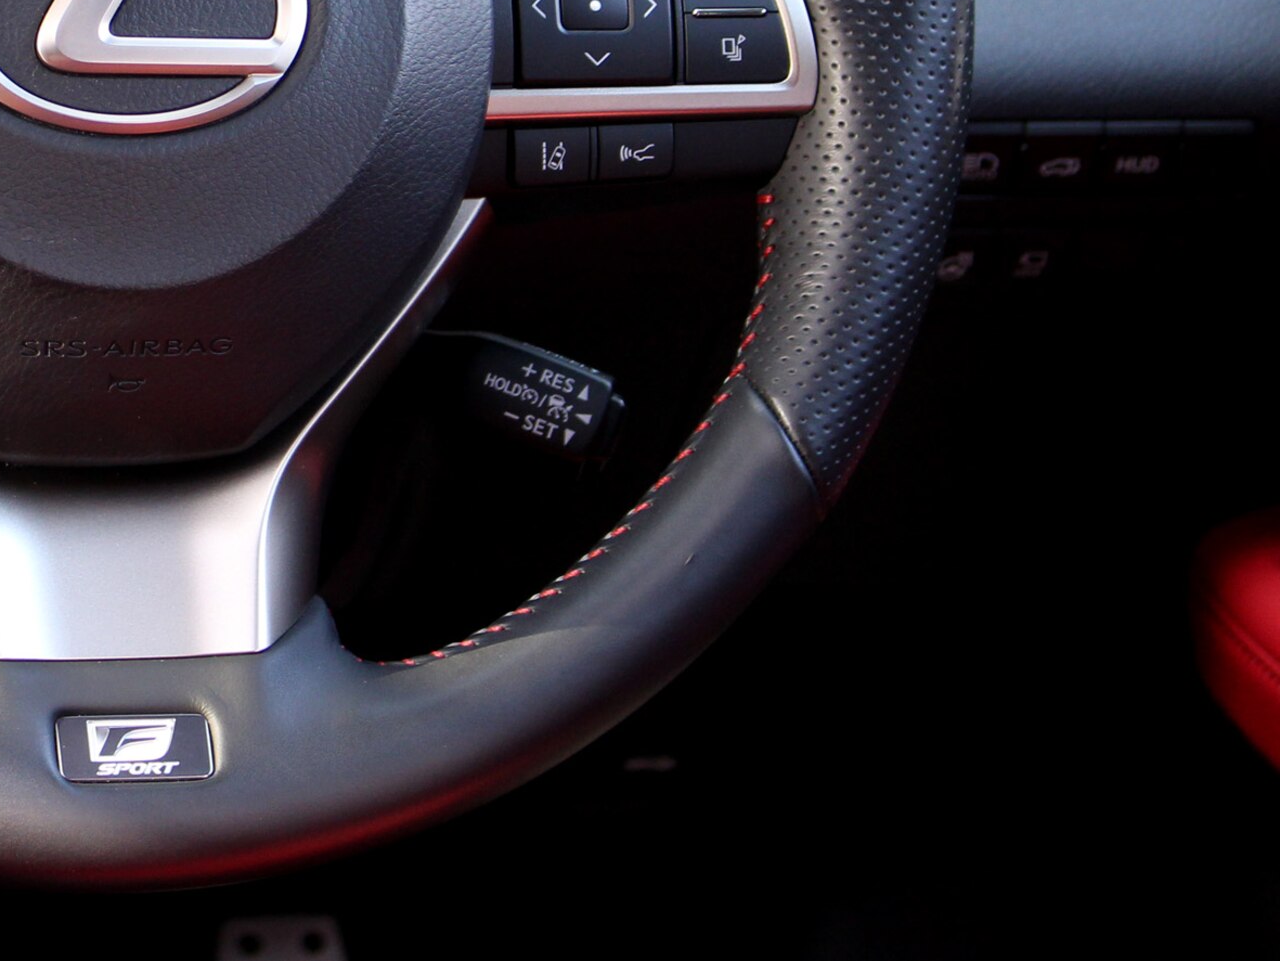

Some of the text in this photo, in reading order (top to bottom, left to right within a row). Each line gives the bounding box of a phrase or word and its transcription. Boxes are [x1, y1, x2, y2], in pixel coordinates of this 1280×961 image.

[1115, 155, 1160, 174] HUD
[20, 339, 234, 358] SRS-AIRBAG
[484, 373, 522, 397] HOLD
[540, 368, 575, 393] RES
[523, 415, 559, 438] SET
[96, 761, 180, 776] SPORT
